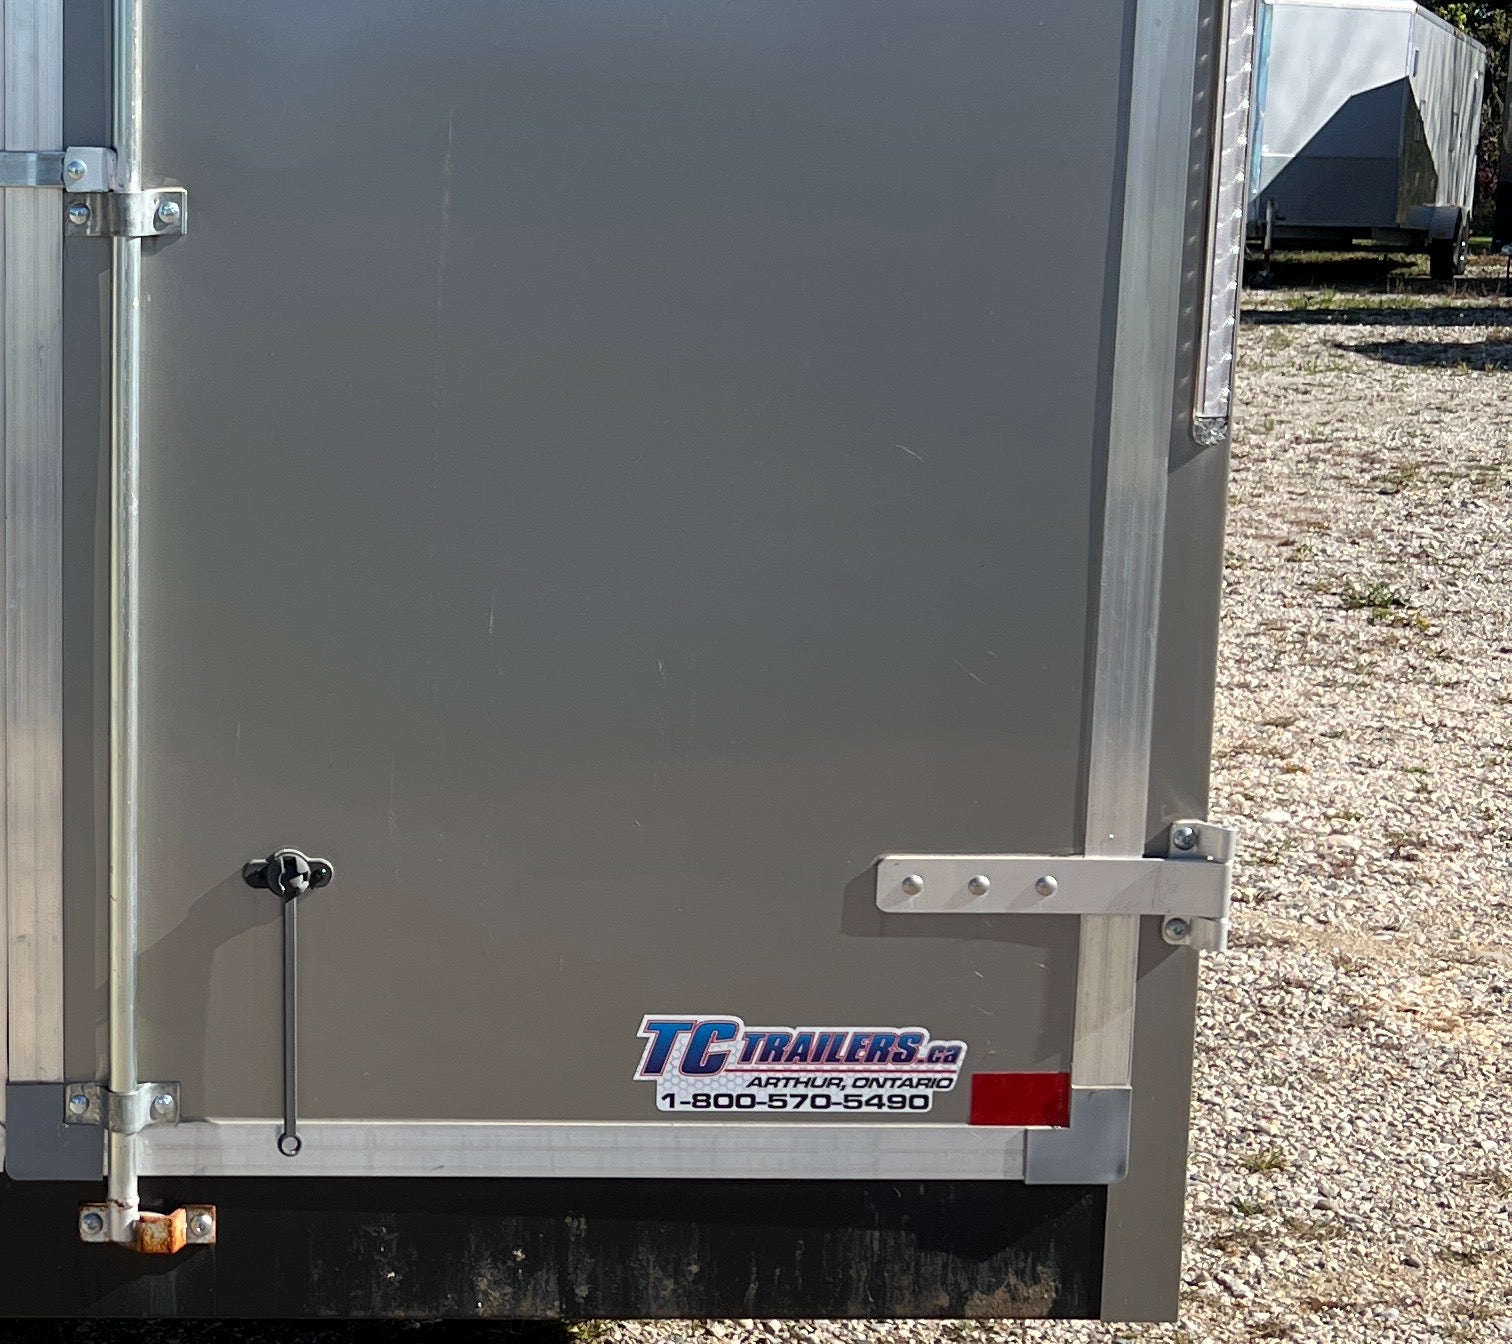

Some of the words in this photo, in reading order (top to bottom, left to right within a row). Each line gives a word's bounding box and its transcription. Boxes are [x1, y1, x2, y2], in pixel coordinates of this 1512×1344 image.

[641, 1020, 739, 1077] TC
[736, 1031, 964, 1065] TRAILERS.ca
[745, 1077, 846, 1091] ARTHUR,
[852, 1077, 954, 1089] ONTARIO
[661, 1093, 930, 1110] 1-800-570-5490
